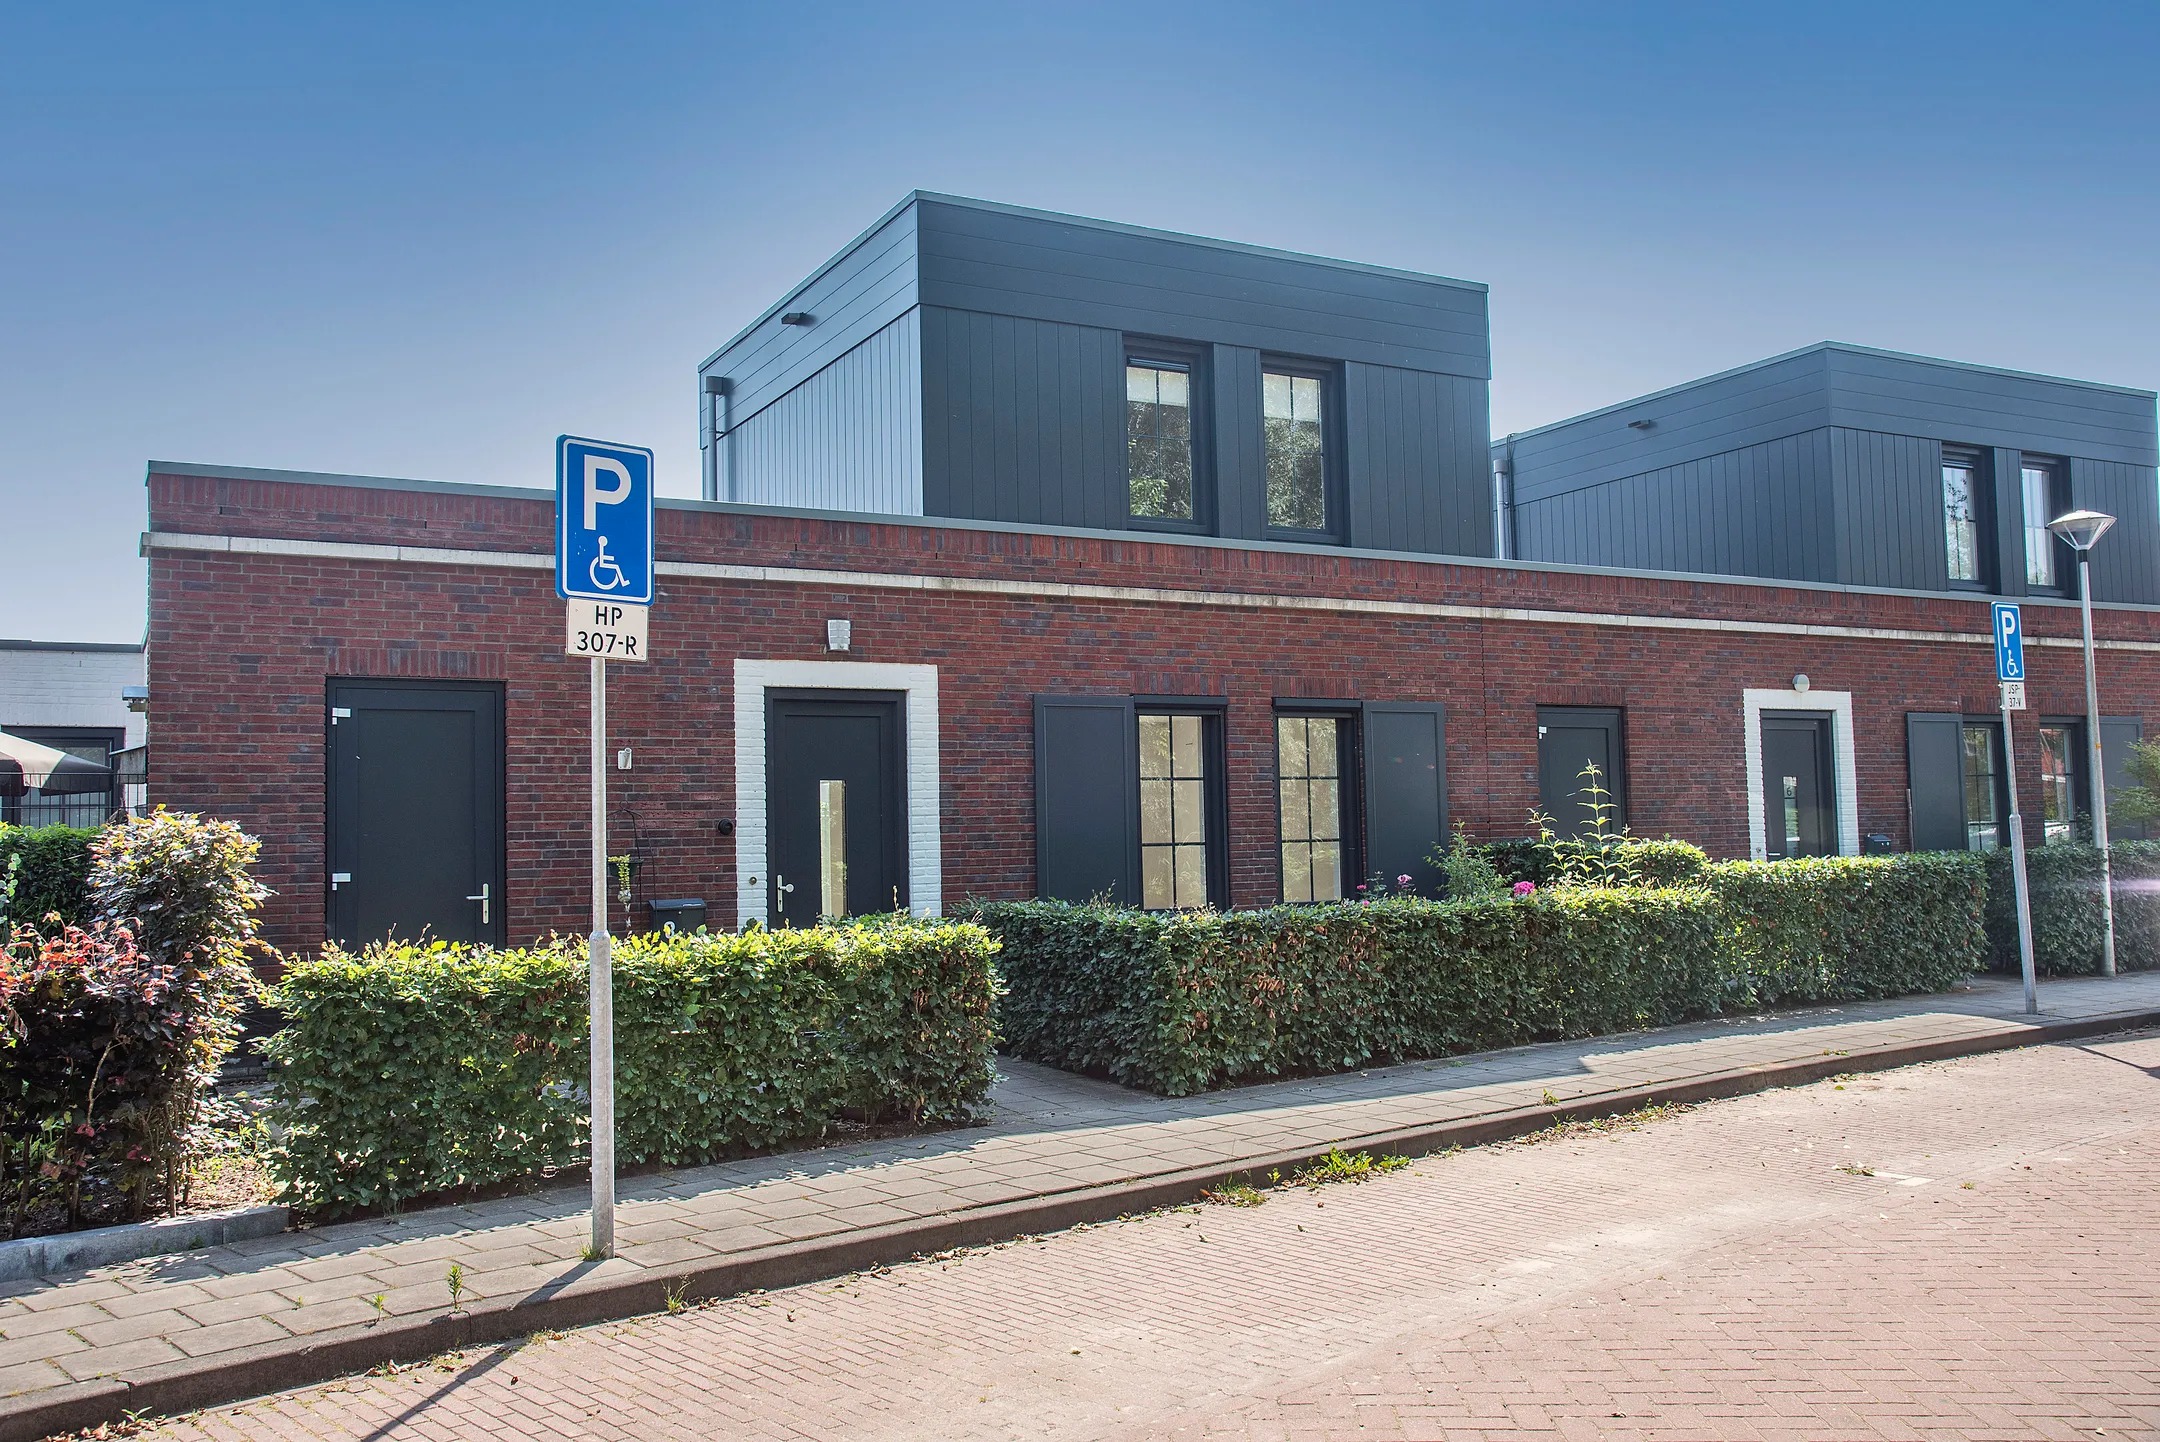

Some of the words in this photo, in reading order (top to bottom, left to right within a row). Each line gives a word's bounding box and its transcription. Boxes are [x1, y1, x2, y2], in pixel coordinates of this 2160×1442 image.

[583, 454, 632, 530] P
[595, 605, 622, 626] HP
[2001, 611, 2016, 647] P
[576, 631, 637, 656] 307-R
